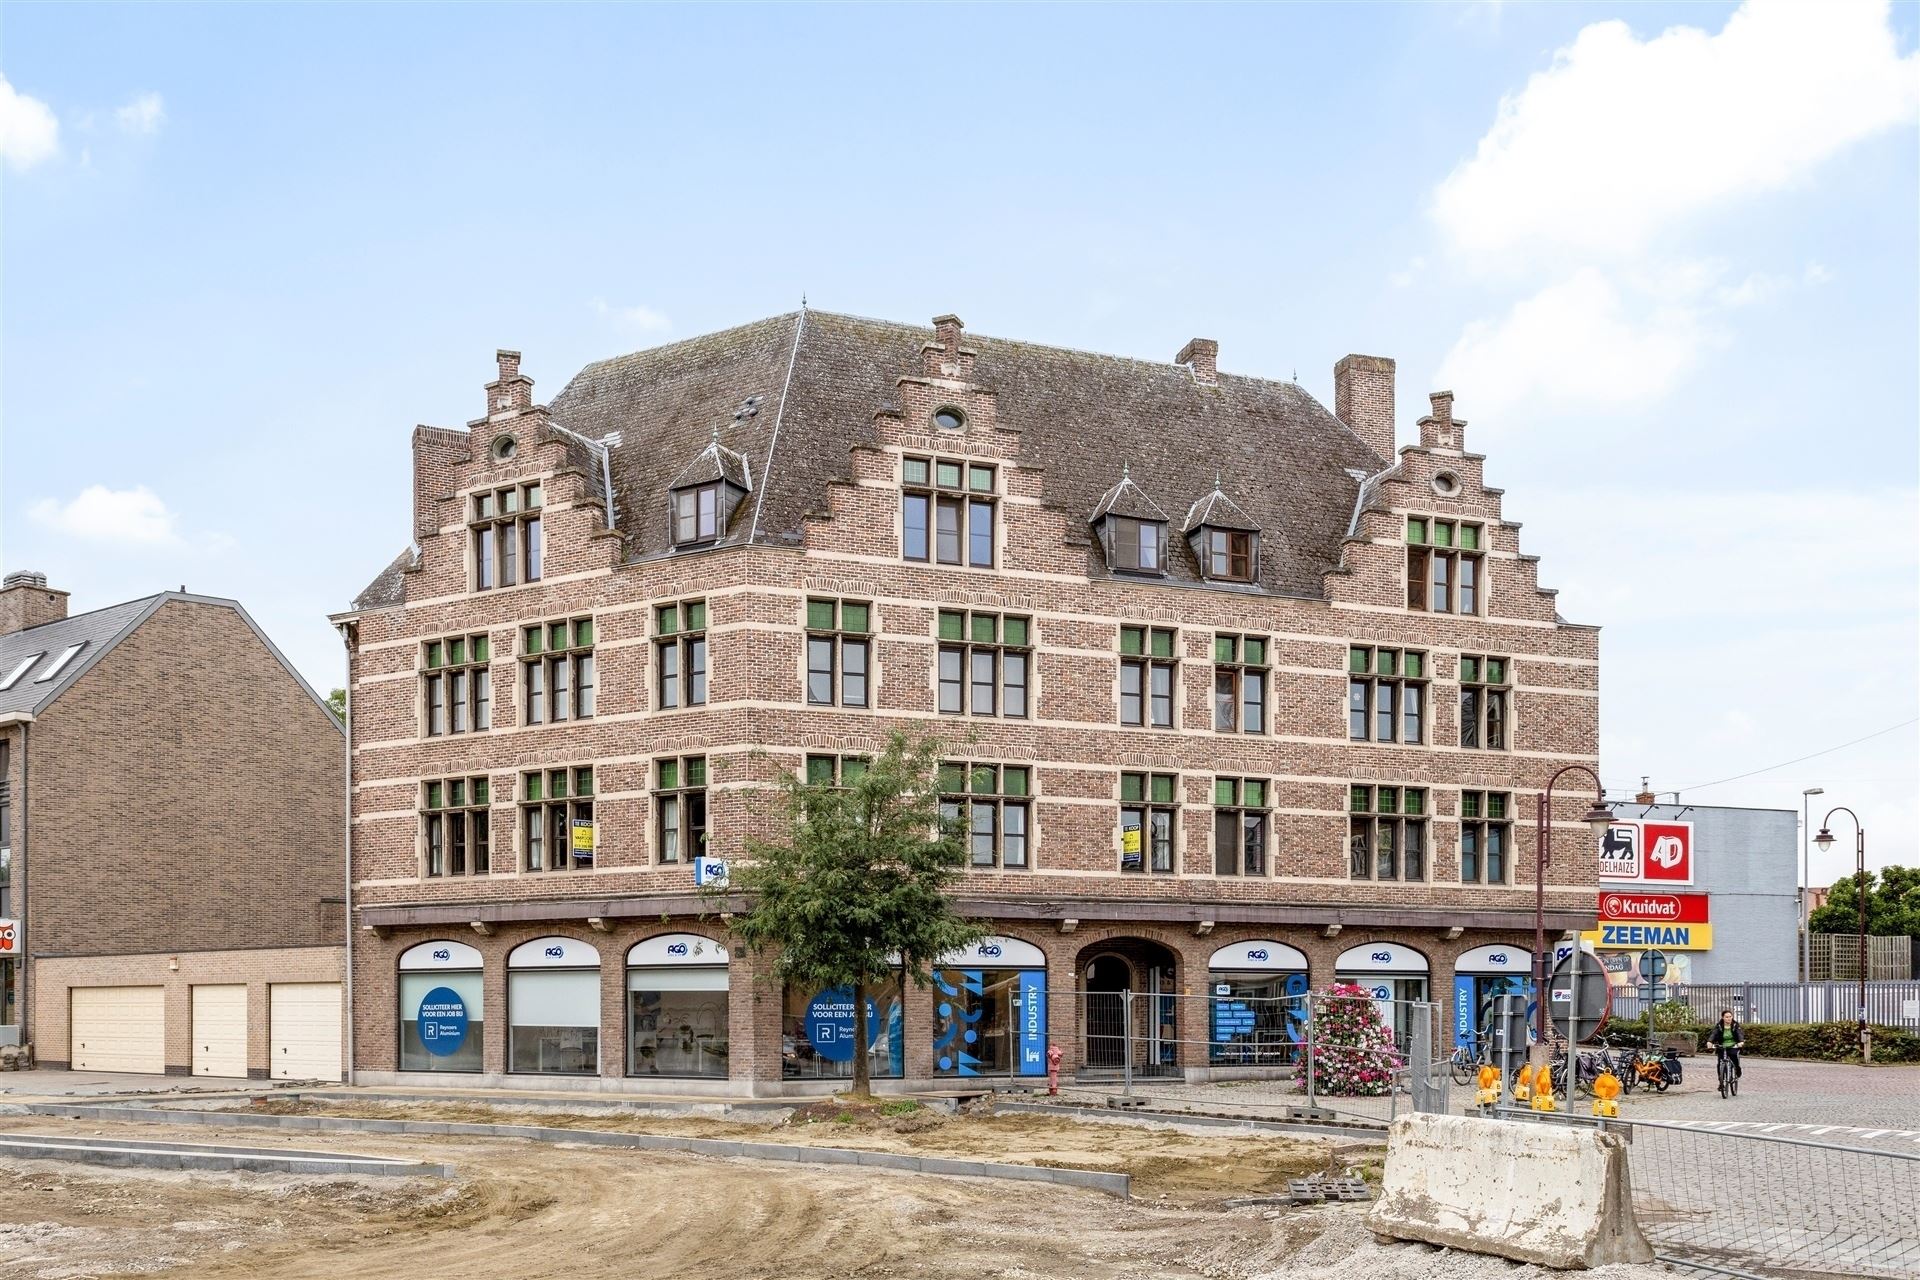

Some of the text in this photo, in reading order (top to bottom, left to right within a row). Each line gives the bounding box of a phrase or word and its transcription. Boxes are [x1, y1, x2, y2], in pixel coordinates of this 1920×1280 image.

[1650, 835, 1683, 869] AD
[705, 864, 724, 876] AGO
[1600, 861, 1634, 873] DELHAIZE
[1623, 899, 1676, 915] Kruidvat
[1602, 925, 1690, 945] ZEEMAN
[433, 950, 449, 959] AGO
[545, 947, 562, 956] AGO
[667, 944, 686, 954] AGO
[978, 946, 1000, 955] AGO
[1247, 950, 1267, 959] AGO
[1371, 952, 1390, 961] AGO
[1488, 954, 1506, 963] AGO
[1028, 985, 1038, 1040] INDUSTRY
[1459, 987, 1468, 1036] NDUSTRY
[428, 1026, 435, 1036] R
[821, 1027, 831, 1039] R
